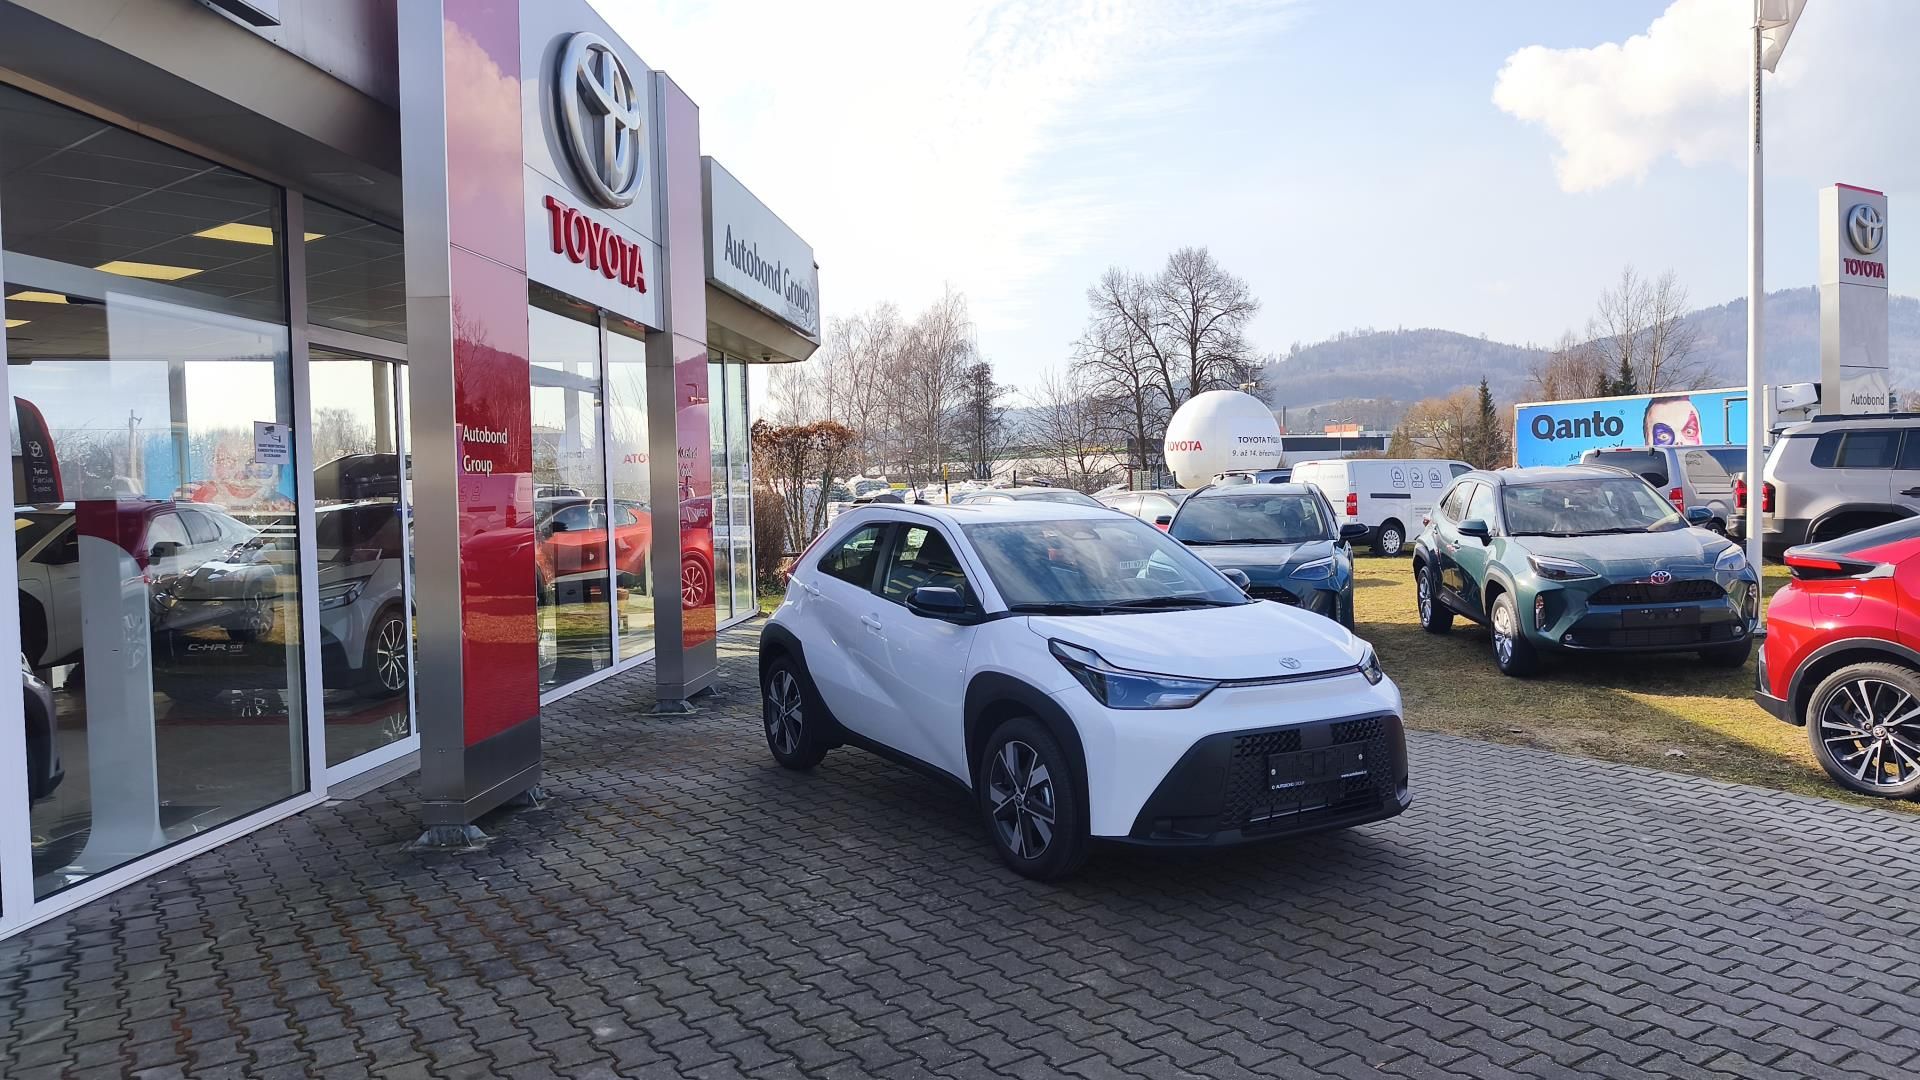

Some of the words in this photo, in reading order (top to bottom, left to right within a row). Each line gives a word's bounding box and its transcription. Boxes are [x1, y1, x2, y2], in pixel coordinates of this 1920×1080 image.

[544, 194, 647, 294] TOYOTA
[724, 223, 781, 296] Autobond
[783, 267, 811, 323] Group
[1843, 257, 1886, 280] TOYOTA
[1850, 392, 1885, 406] Autobond
[463, 425, 508, 445] Autobond
[1531, 410, 1624, 441] Qanto
[1237, 436, 1266, 444] TOYOTA
[463, 455, 493, 477] Group
